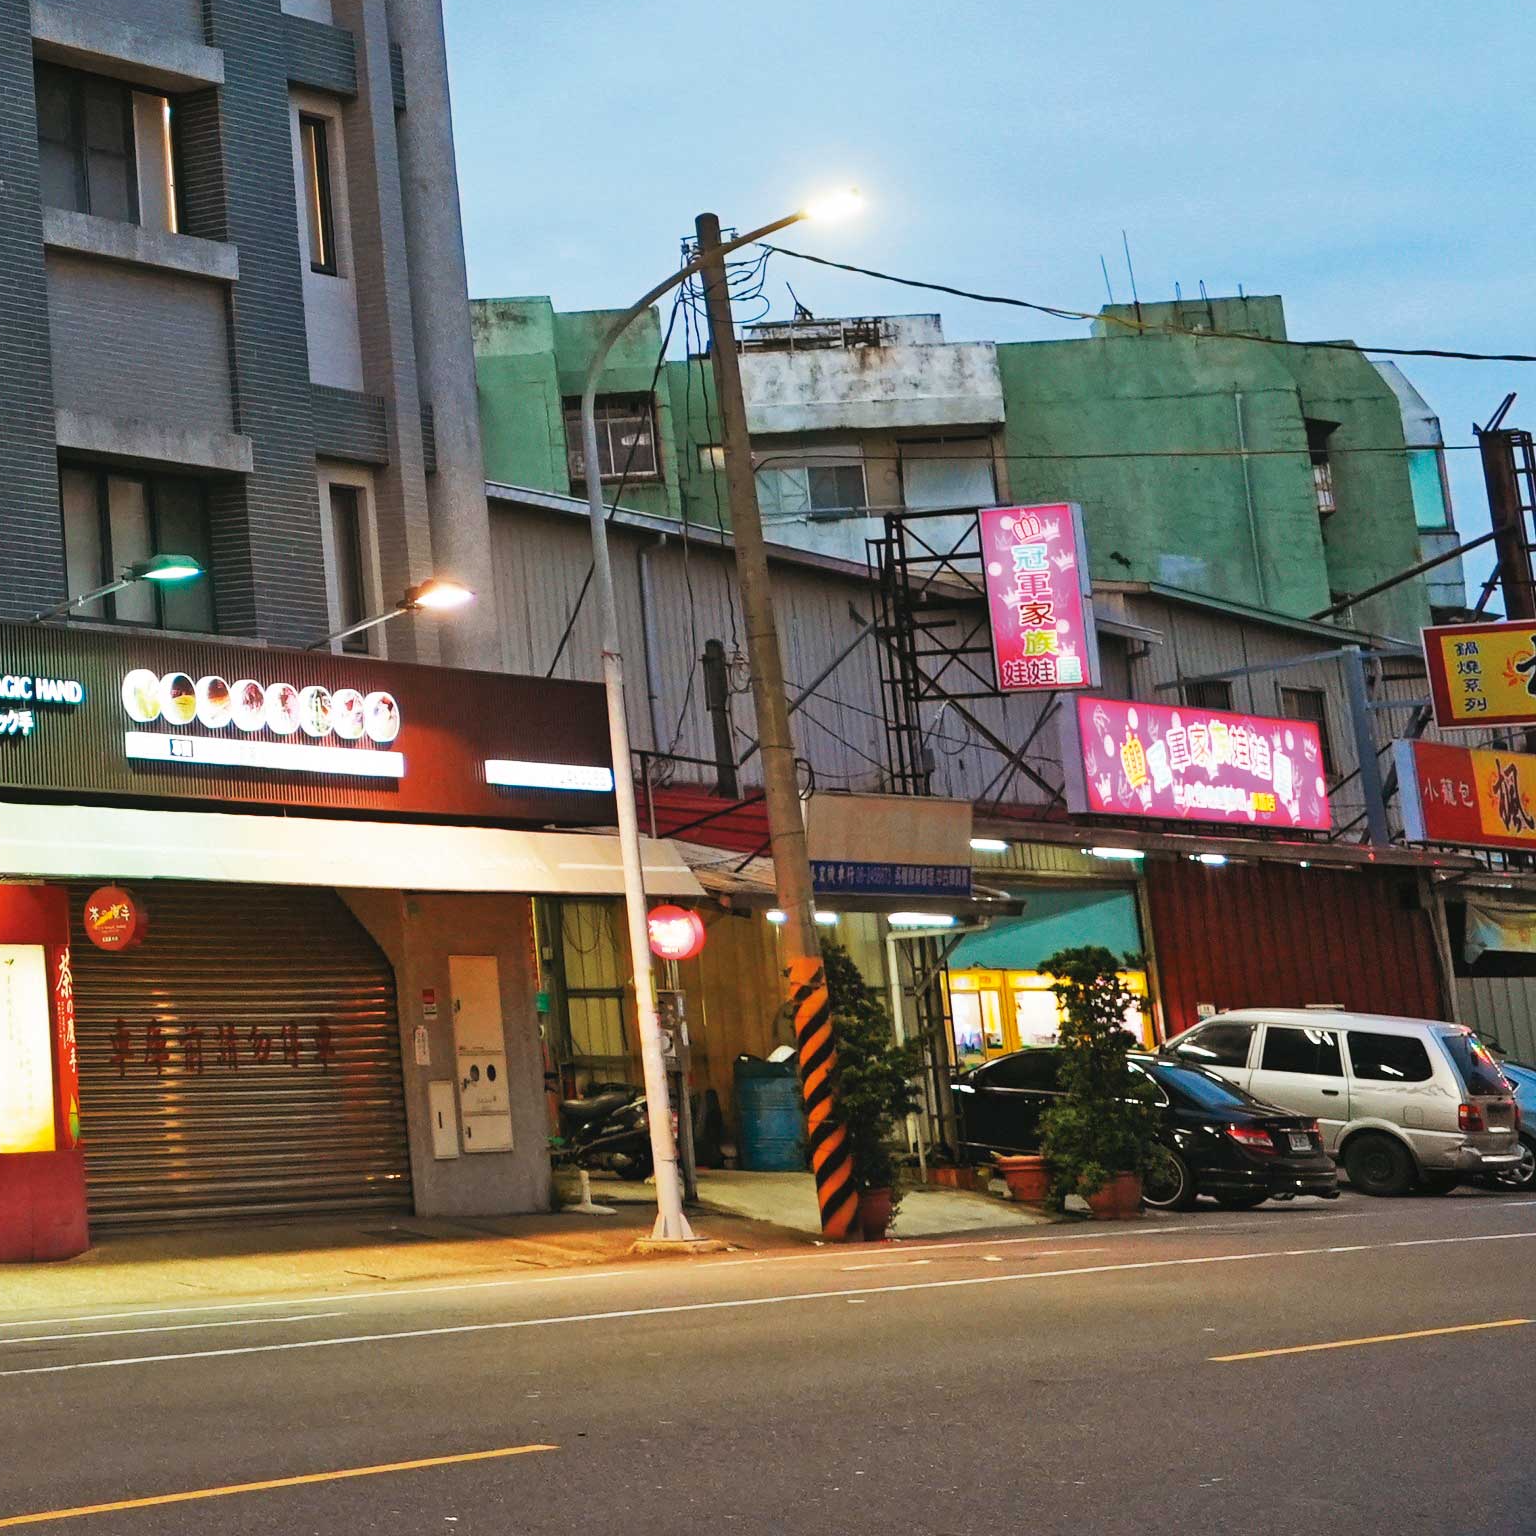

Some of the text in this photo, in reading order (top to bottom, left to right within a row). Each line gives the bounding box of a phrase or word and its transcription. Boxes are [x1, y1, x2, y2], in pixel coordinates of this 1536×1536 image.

[1011, 543, 1059, 656] 冠軍家族
[1003, 655, 1083, 685] 娃娃屋
[35, 677, 83, 703] HAND
